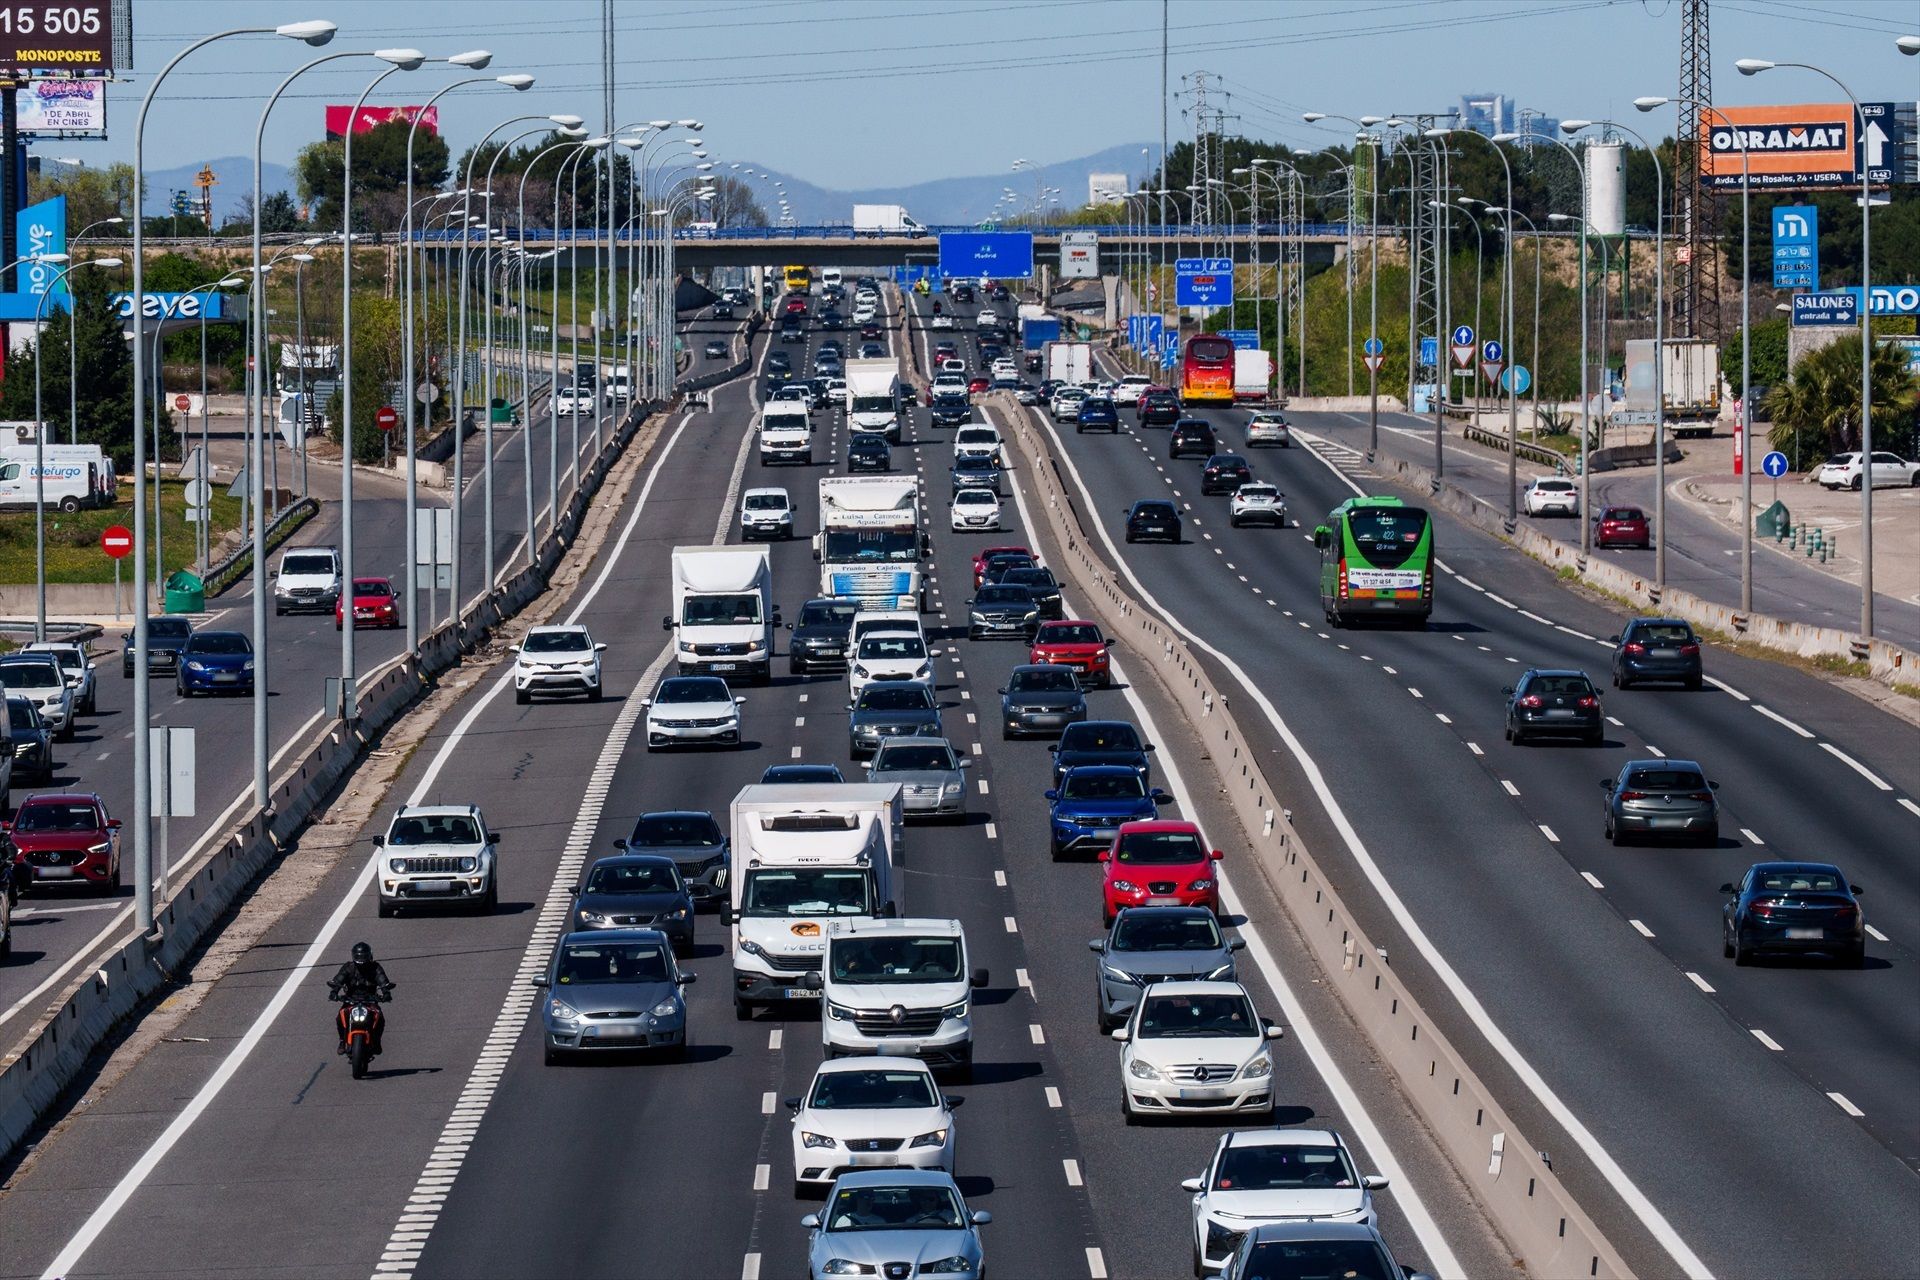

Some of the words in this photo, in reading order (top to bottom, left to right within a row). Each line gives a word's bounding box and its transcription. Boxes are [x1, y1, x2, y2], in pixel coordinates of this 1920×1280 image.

[0, 8, 35, 34] 15
[44, 8, 100, 34] 505
[15, 50, 101, 62] MONOPOSTE
[44, 110, 47, 118] 1
[50, 110, 62, 118] DE
[65, 110, 92, 118] ABRIL
[1712, 128, 1843, 150] OBRAMAT
[1714, 176, 1737, 185] Avda.
[1749, 175, 1761, 184] los
[1797, 174, 1807, 182] 24
[1814, 173, 1842, 182] USERA
[107, 294, 200, 317] oeve
[1796, 296, 1854, 308] SALONES
